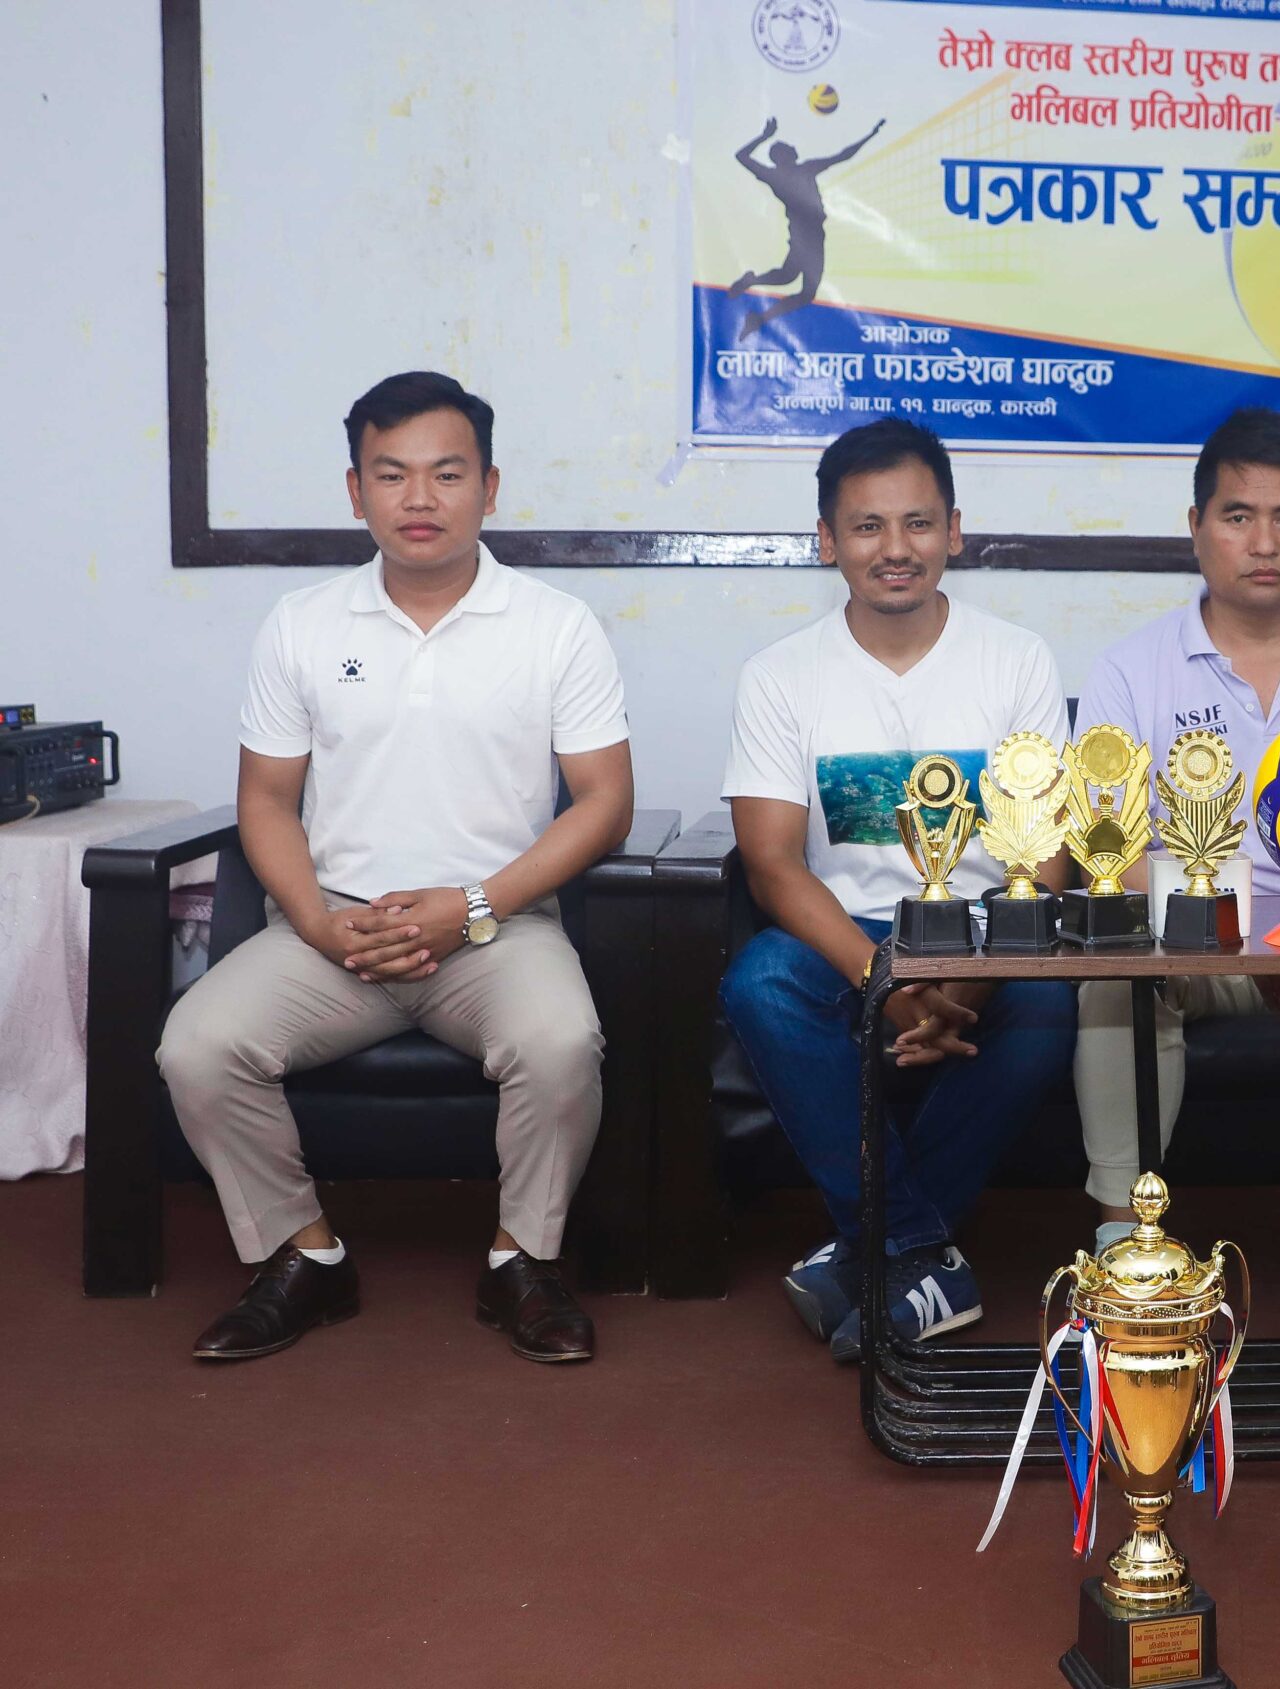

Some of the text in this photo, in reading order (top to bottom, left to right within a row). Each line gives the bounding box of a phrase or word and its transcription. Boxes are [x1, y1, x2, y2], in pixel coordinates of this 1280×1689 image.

[1005, 40, 1073, 71] क्लब
[1083, 37, 1174, 76] स्तरीय
[1011, 84, 1119, 127] भलिबल
[940, 157, 1164, 231] पत्रकार
[861, 321, 950, 345] आयोजक
[716, 347, 1115, 394] लामा अमृत फाउन्डेशन घान्द्रुक
[1000, 396, 1057, 416] कास्की
[1175, 704, 1222, 729] NSJF
